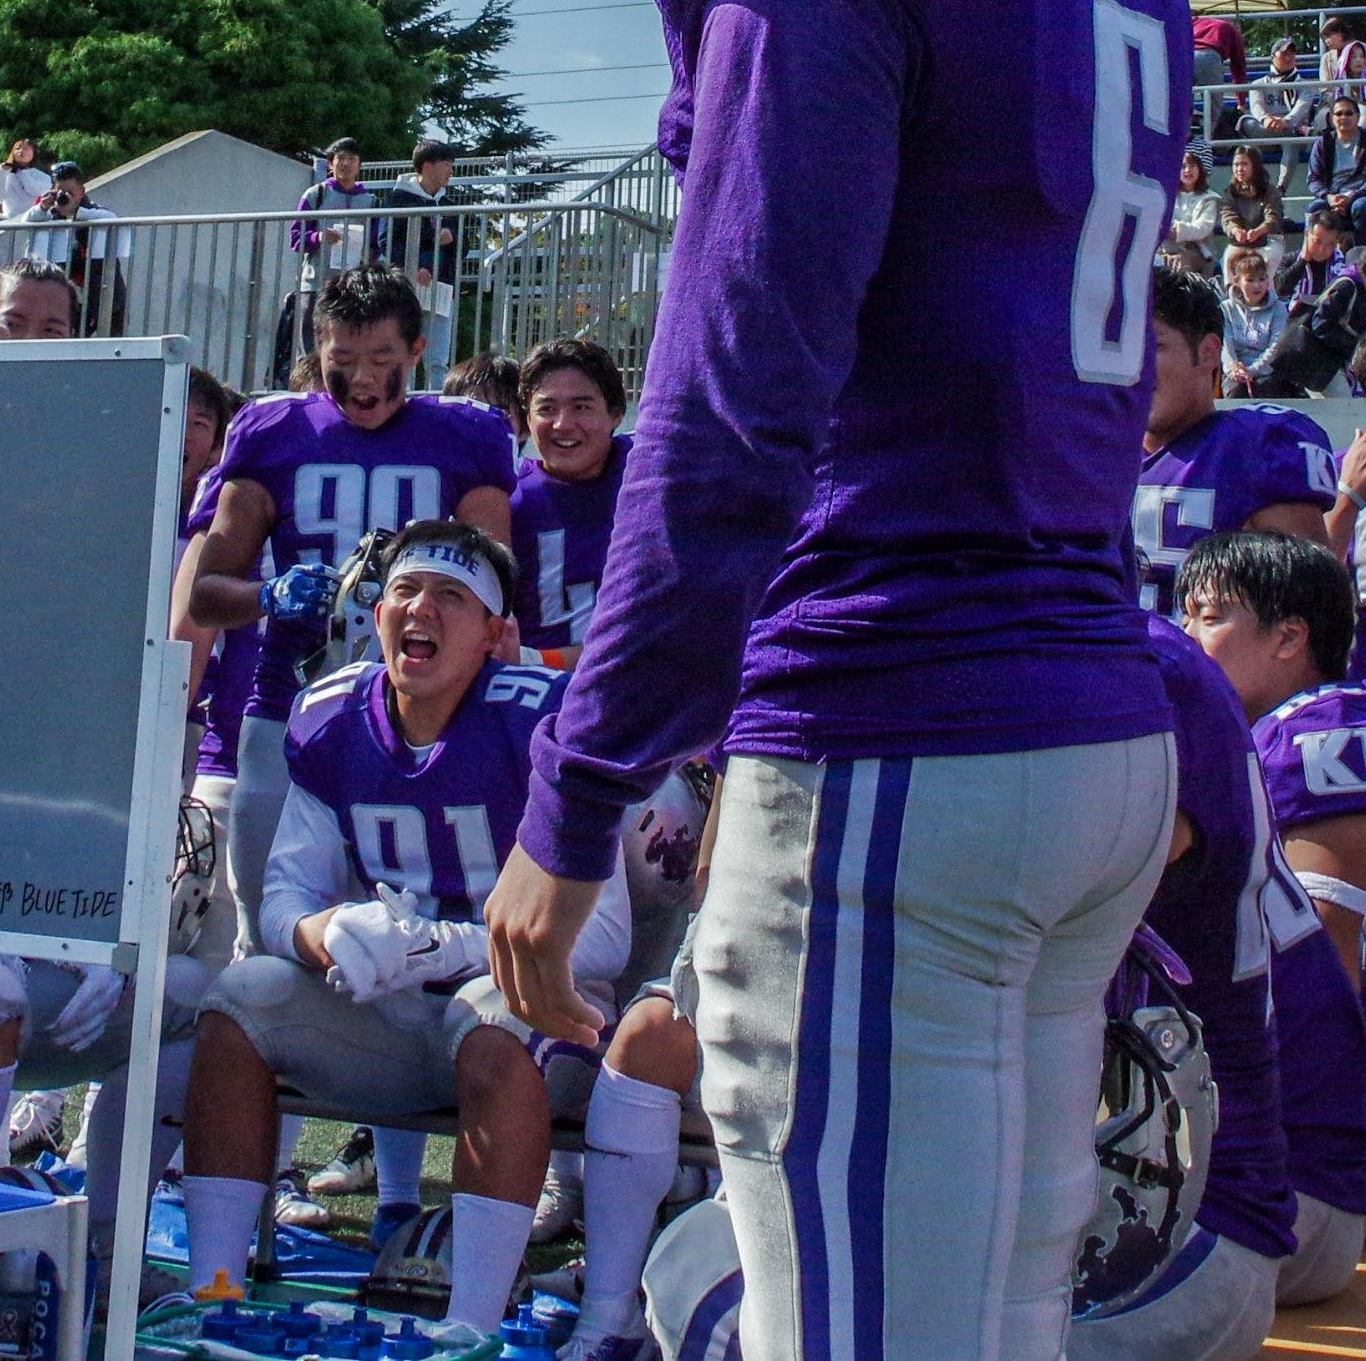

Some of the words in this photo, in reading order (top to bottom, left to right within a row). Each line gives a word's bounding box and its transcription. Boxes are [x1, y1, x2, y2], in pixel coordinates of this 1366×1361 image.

[426, 543, 480, 577] TIDE
[350, 803, 501, 923] 91
[21, 881, 68, 917] BLUE
